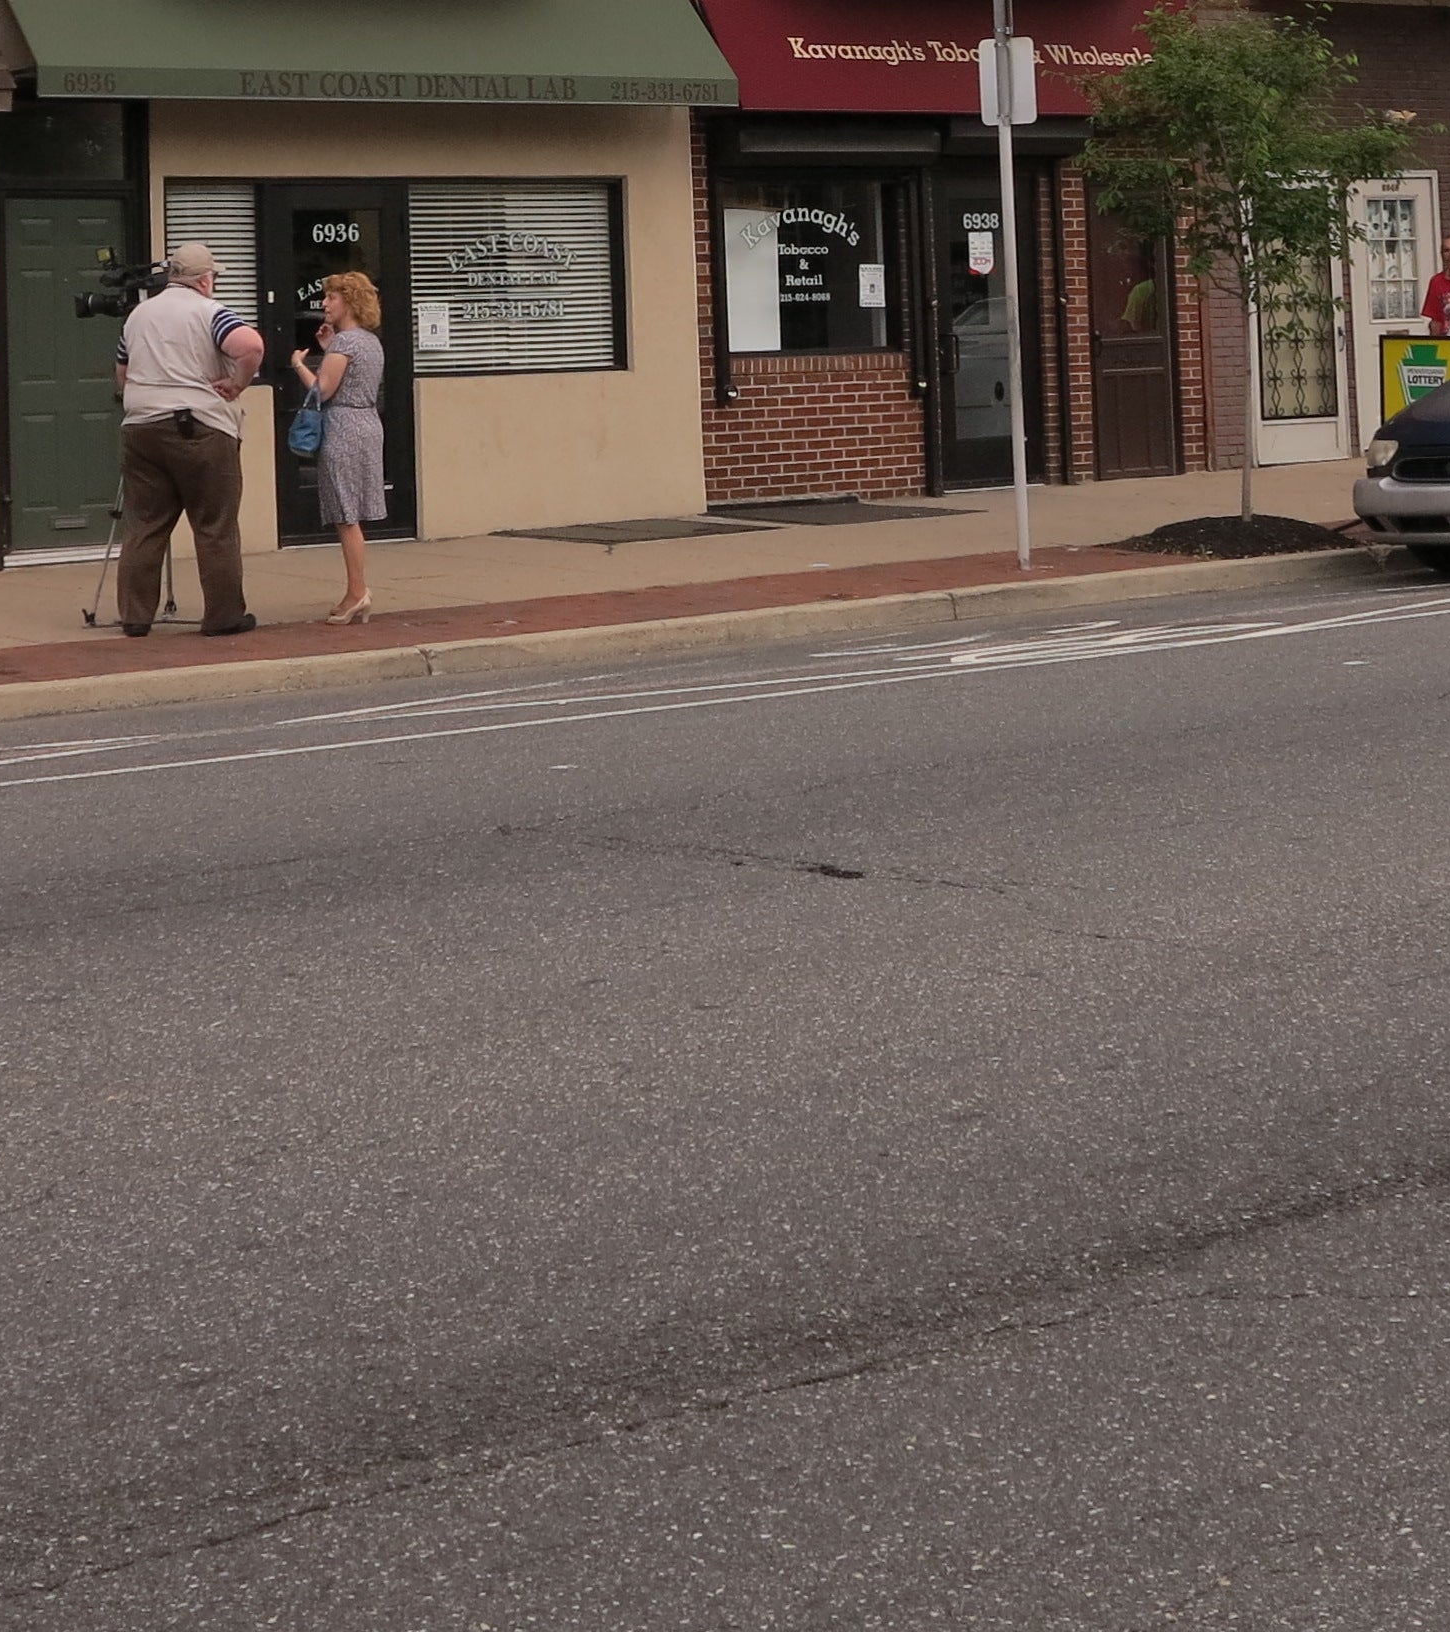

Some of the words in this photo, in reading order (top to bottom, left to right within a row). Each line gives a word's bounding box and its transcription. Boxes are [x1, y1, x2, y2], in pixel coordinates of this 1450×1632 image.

[787, 36, 925, 66] Kavanagh's
[63, 71, 116, 93] 6936
[239, 71, 309, 96] EAST
[319, 72, 406, 98] COAST
[415, 74, 519, 99] DENTAL
[526, 76, 577, 100] LAB
[610, 80, 719, 102] 215-331-6781
[740, 206, 861, 249] Kavanagh's
[963, 212, 1000, 229] 6938
[312, 223, 360, 243] 6936
[446, 233, 501, 274] EAST
[508, 231, 578, 270] COAST
[778, 243, 829, 255] Tobacco
[799, 258, 810, 270] &
[467, 272, 523, 287] DENTAL
[528, 271, 559, 285] LAB
[785, 274, 823, 286] Retail
[462, 300, 565, 320] 215-331-6781
[1407, 374, 1445, 385] LOTTERY
